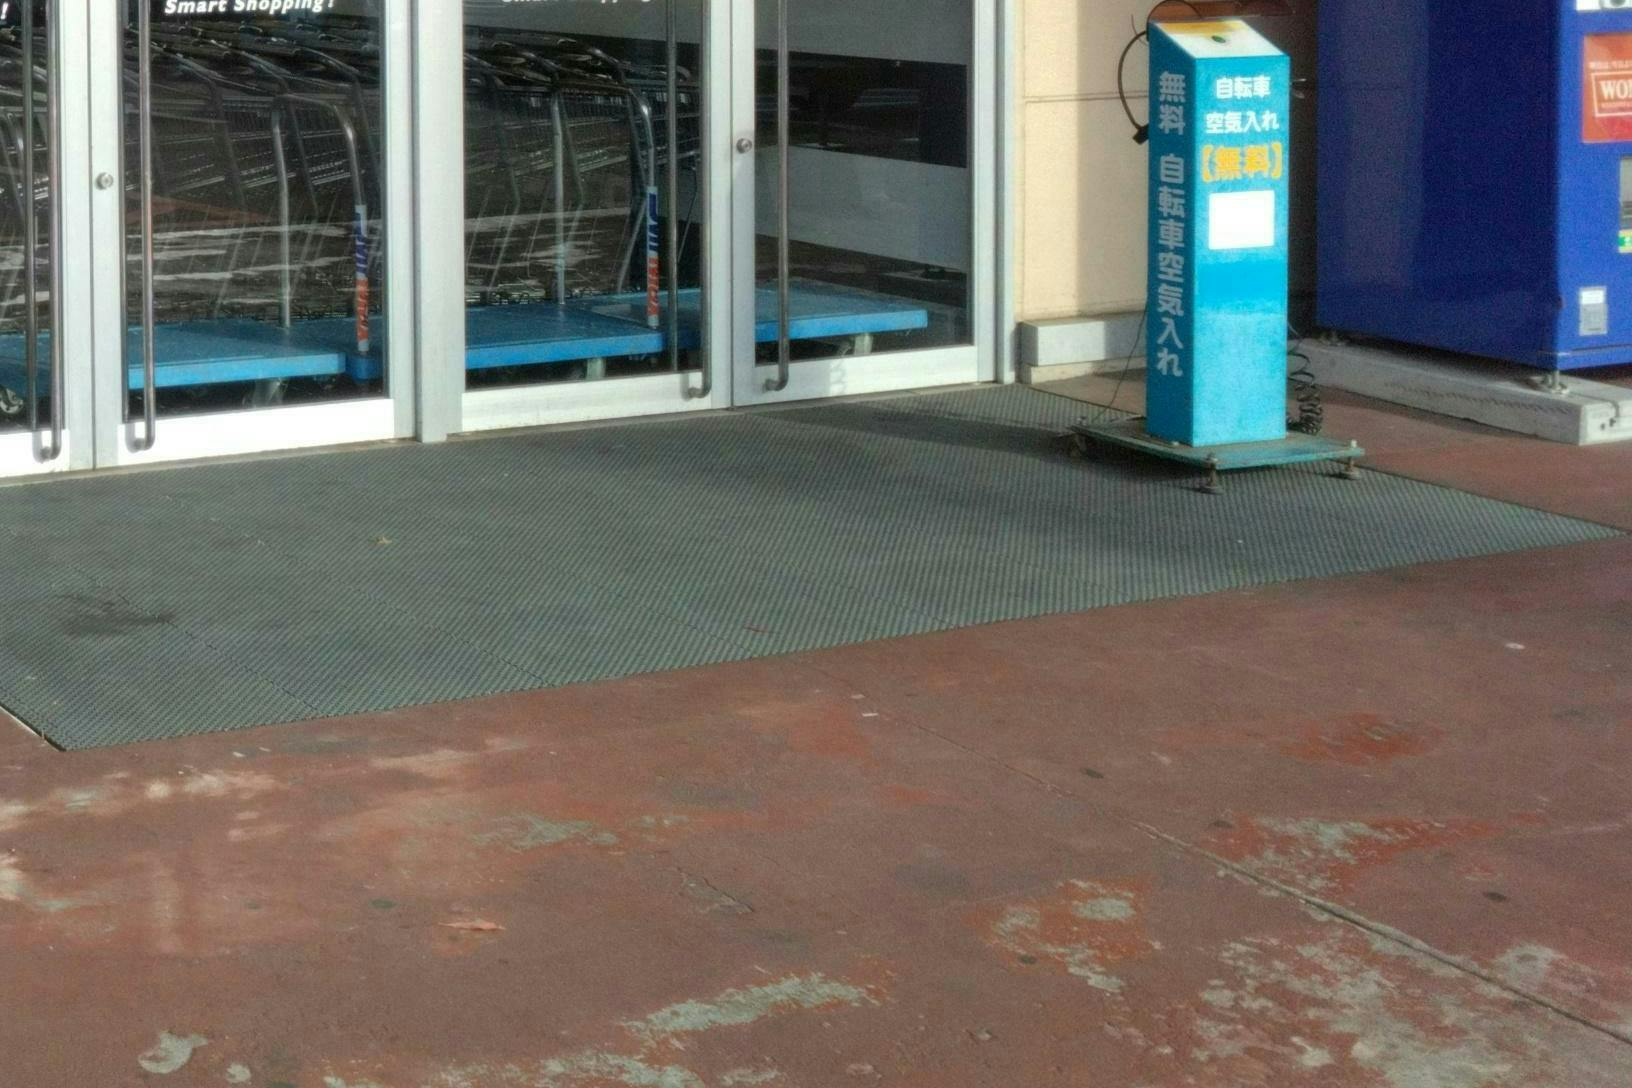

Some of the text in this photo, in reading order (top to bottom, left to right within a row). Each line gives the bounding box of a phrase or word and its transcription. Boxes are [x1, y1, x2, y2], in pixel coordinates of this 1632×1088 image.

[1215, 75, 1271, 100] 自転車
[1599, 79, 1632, 101] WO
[1205, 110, 1280, 134] 空気入れ
[1156, 70, 1186, 377] 無料 自転車空気入れ
